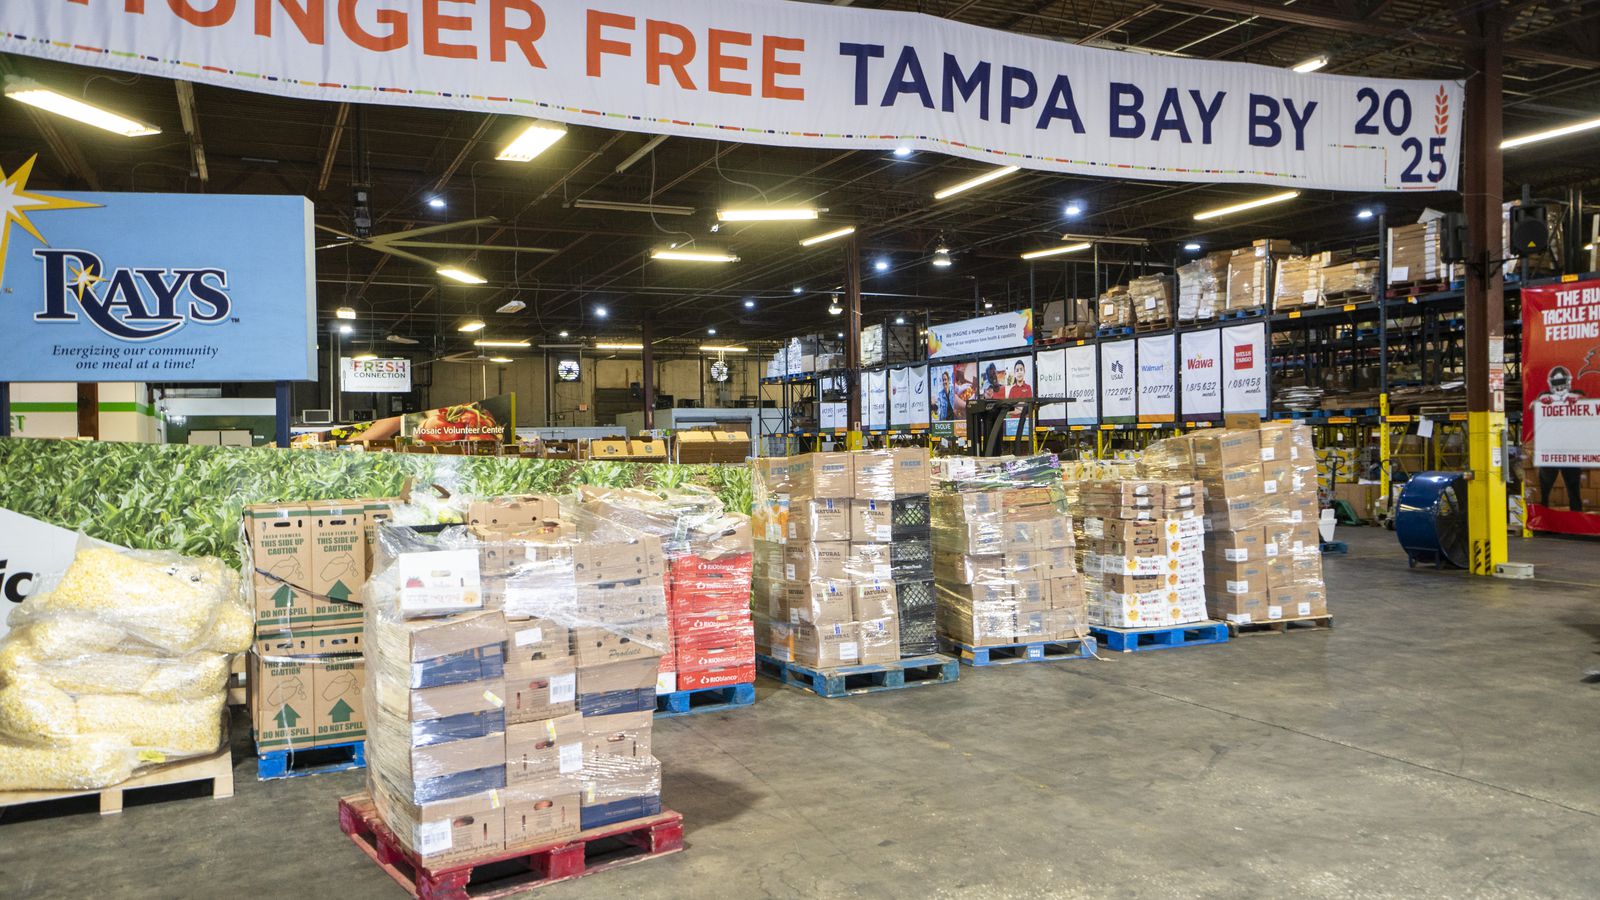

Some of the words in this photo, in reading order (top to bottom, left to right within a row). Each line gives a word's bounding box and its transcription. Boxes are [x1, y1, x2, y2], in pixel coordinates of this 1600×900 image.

[586, 9, 805, 101] FREE
[840, 42, 1086, 134] TAMPA
[1110, 82, 1226, 145] BAY
[1248, 92, 1318, 151] BY
[1355, 87, 1412, 136] 20
[1400, 137, 1447, 184] 25
[33, 248, 232, 342] RAYS
[1555, 290, 1581, 308] THE
[1541, 307, 1586, 325] TACKLE
[1545, 322, 1599, 342] FEEDING
[52, 345, 120, 358] Energizing
[124, 347, 146, 355] our
[149, 345, 219, 359] community
[76, 361, 99, 369] one
[102, 359, 132, 369] meal
[136, 360, 149, 369] at
[163, 358, 195, 369] time!
[354, 360, 406, 372] FRESH
[1188, 358, 1213, 370] Wawa
[413, 426, 441, 435] Mosaic
[442, 426, 480, 434] Volunteer
[482, 425, 504, 434] Center
[1551, 454, 1567, 462] FEED
[1568, 454, 1581, 462] THE
[268, 547, 298, 556] CAUTION
[271, 668, 300, 676] CAUTION
[326, 663, 354, 672] CAUTION
[330, 723, 343, 731] NOT
[345, 722, 363, 730] SPILL
